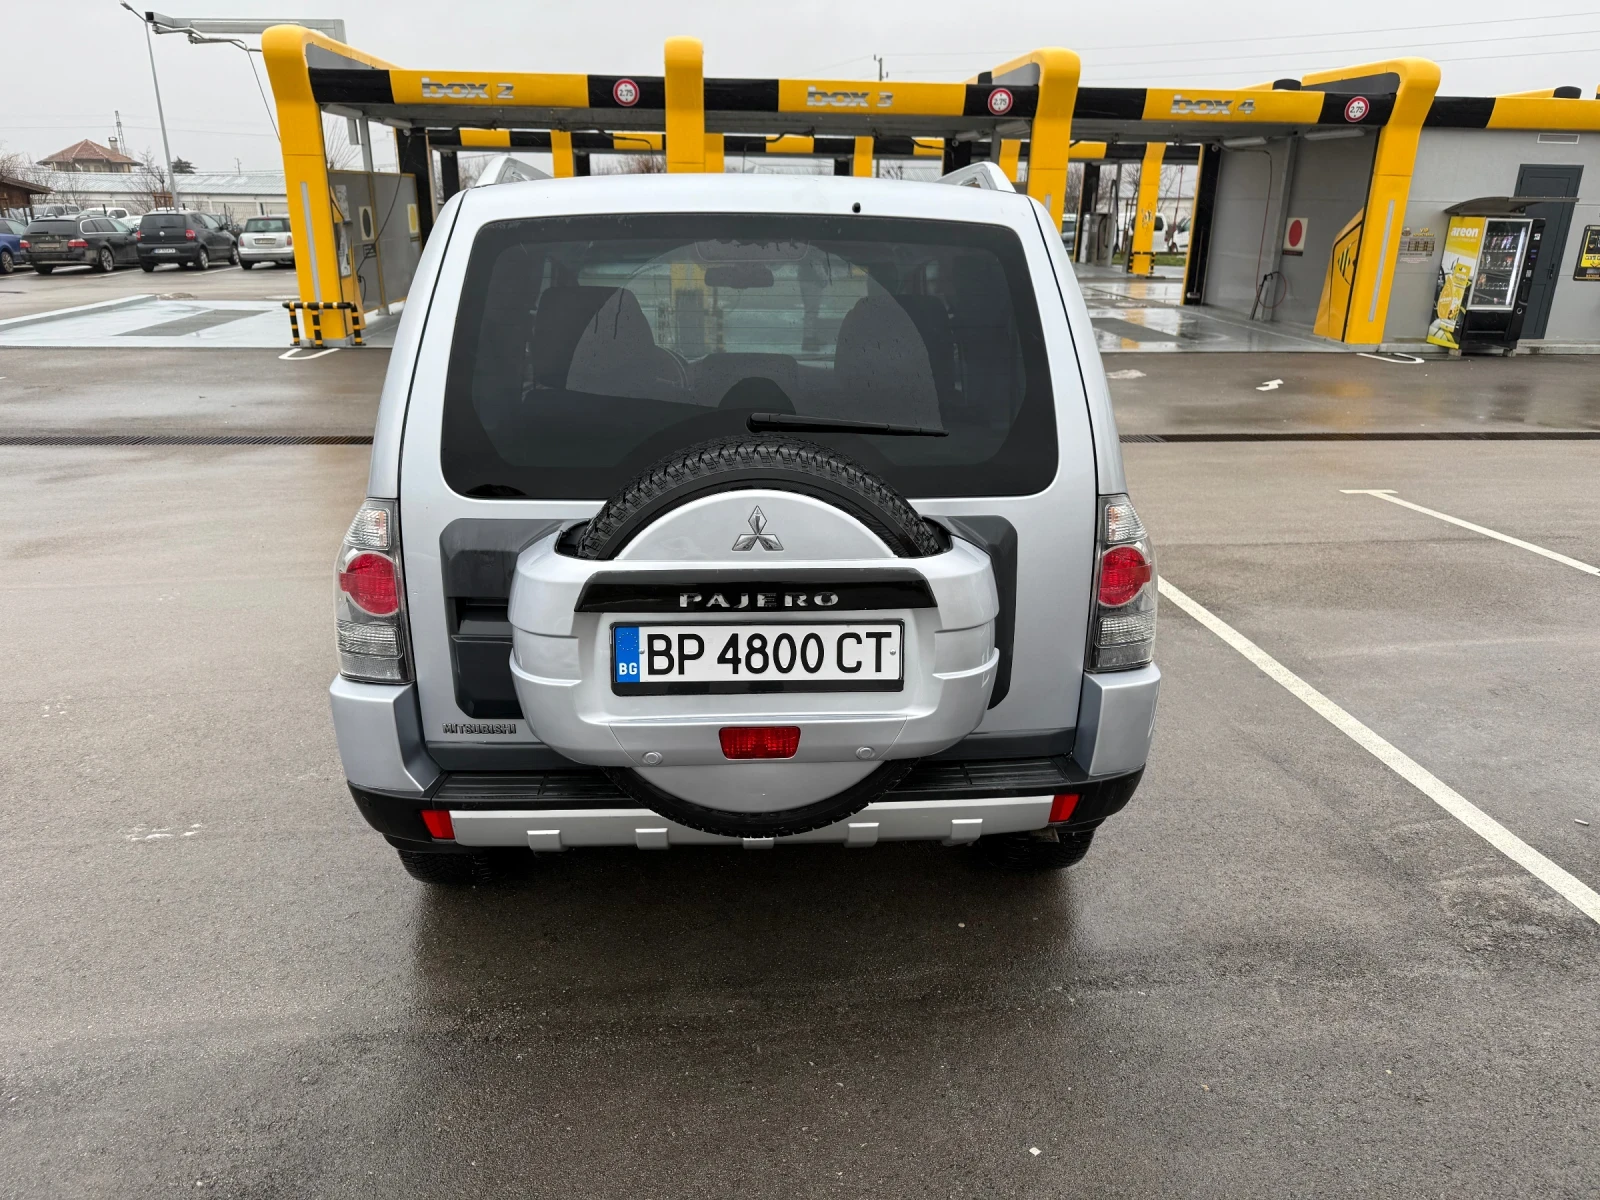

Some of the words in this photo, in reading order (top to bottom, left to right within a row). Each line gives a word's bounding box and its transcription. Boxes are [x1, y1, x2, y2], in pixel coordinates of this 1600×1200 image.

[421, 77, 489, 99] box
[496, 83, 514, 99] 2
[619, 88, 634, 98] 2.75
[806, 85, 870, 107] box
[876, 91, 893, 107] 3
[993, 97, 1008, 106] 2.75
[1170, 94, 1234, 115] box
[1237, 98, 1256, 114] 4
[1349, 105, 1364, 114] 2.75
[1451, 226, 1479, 237] areon
[679, 592, 839, 608] PAJERO
[647, 633, 705, 675] BP
[717, 632, 825, 675] 4800
[836, 632, 893, 673] CT
[619, 662, 638, 675] BG
[442, 723, 517, 734] MITSUBISHI
